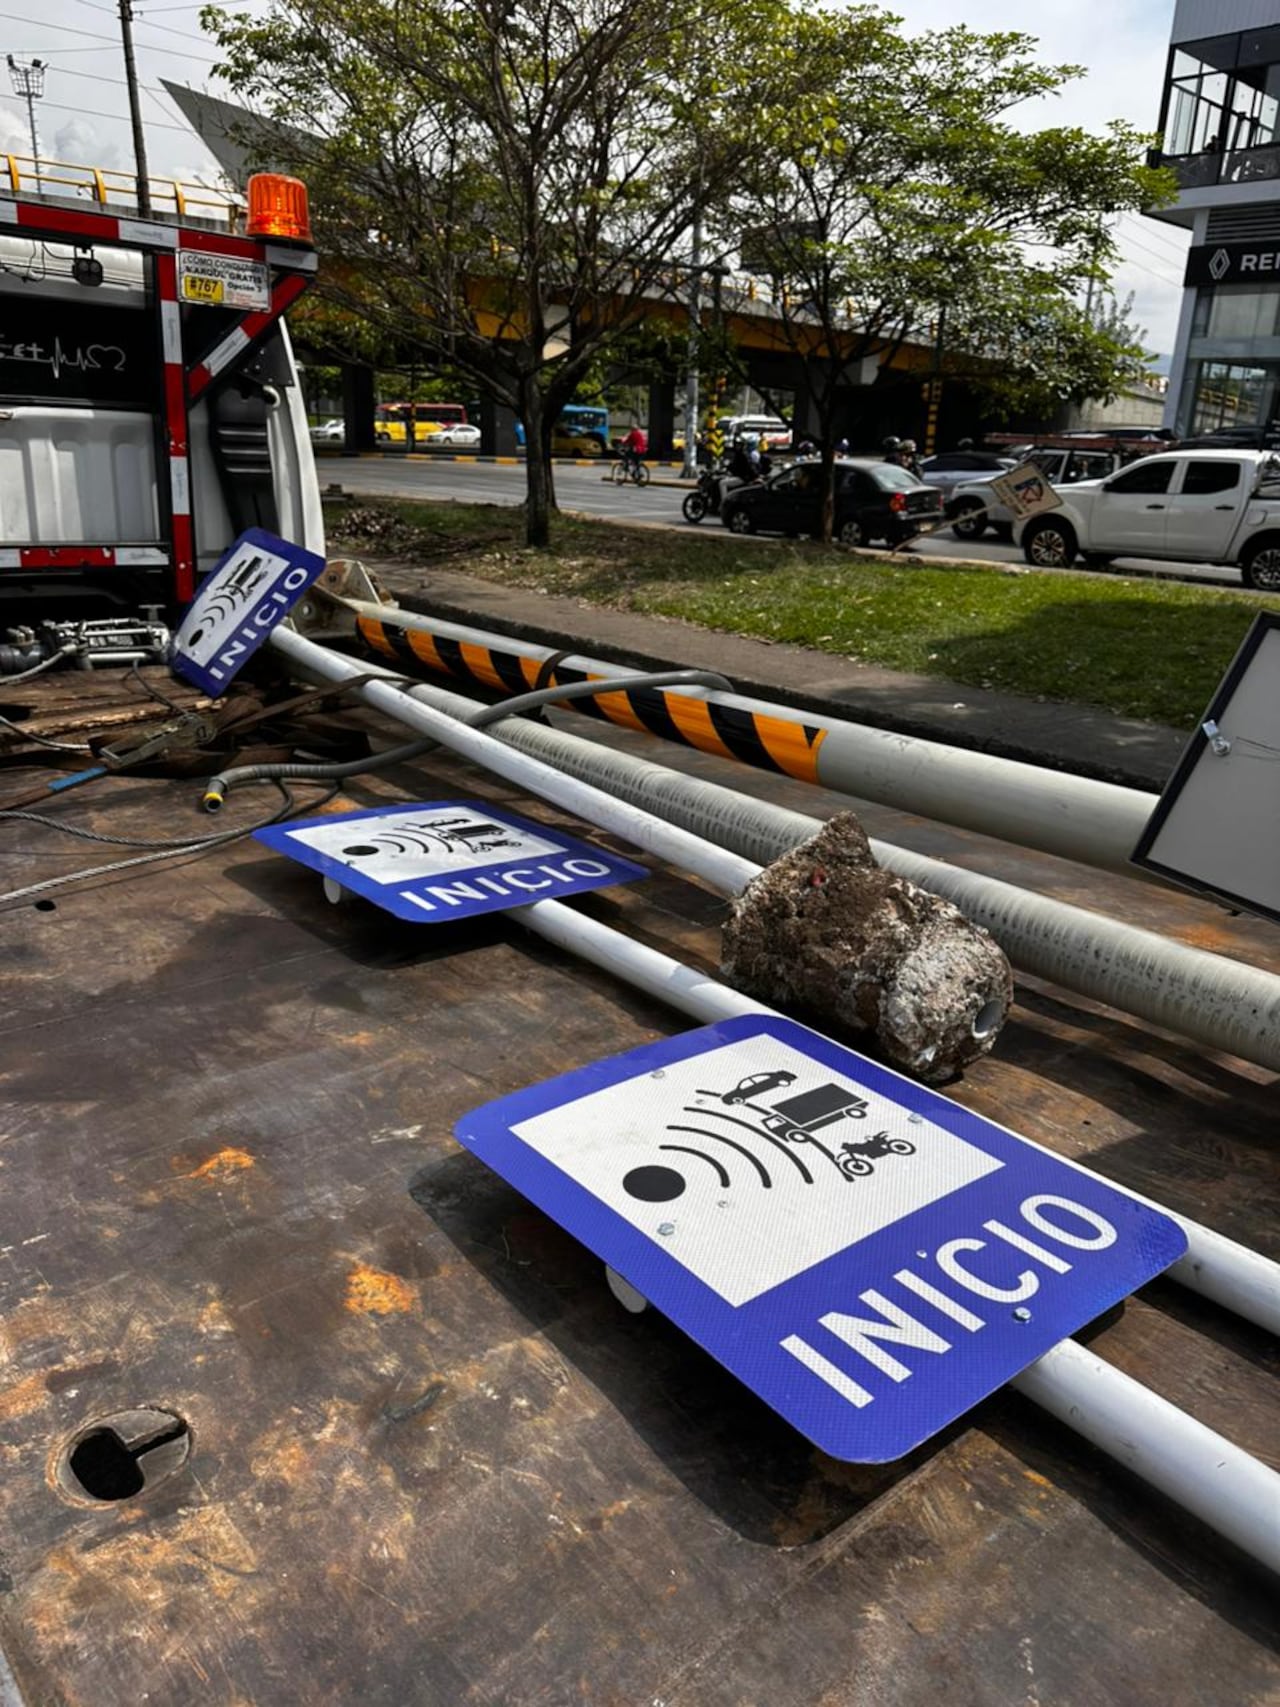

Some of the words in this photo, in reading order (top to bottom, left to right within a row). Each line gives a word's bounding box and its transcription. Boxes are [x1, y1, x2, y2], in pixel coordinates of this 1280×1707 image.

[190, 278, 218, 293] #767
[209, 568, 308, 680] INICIO
[399, 859, 611, 911] INICIO
[779, 1194, 1118, 1409] INICIO
